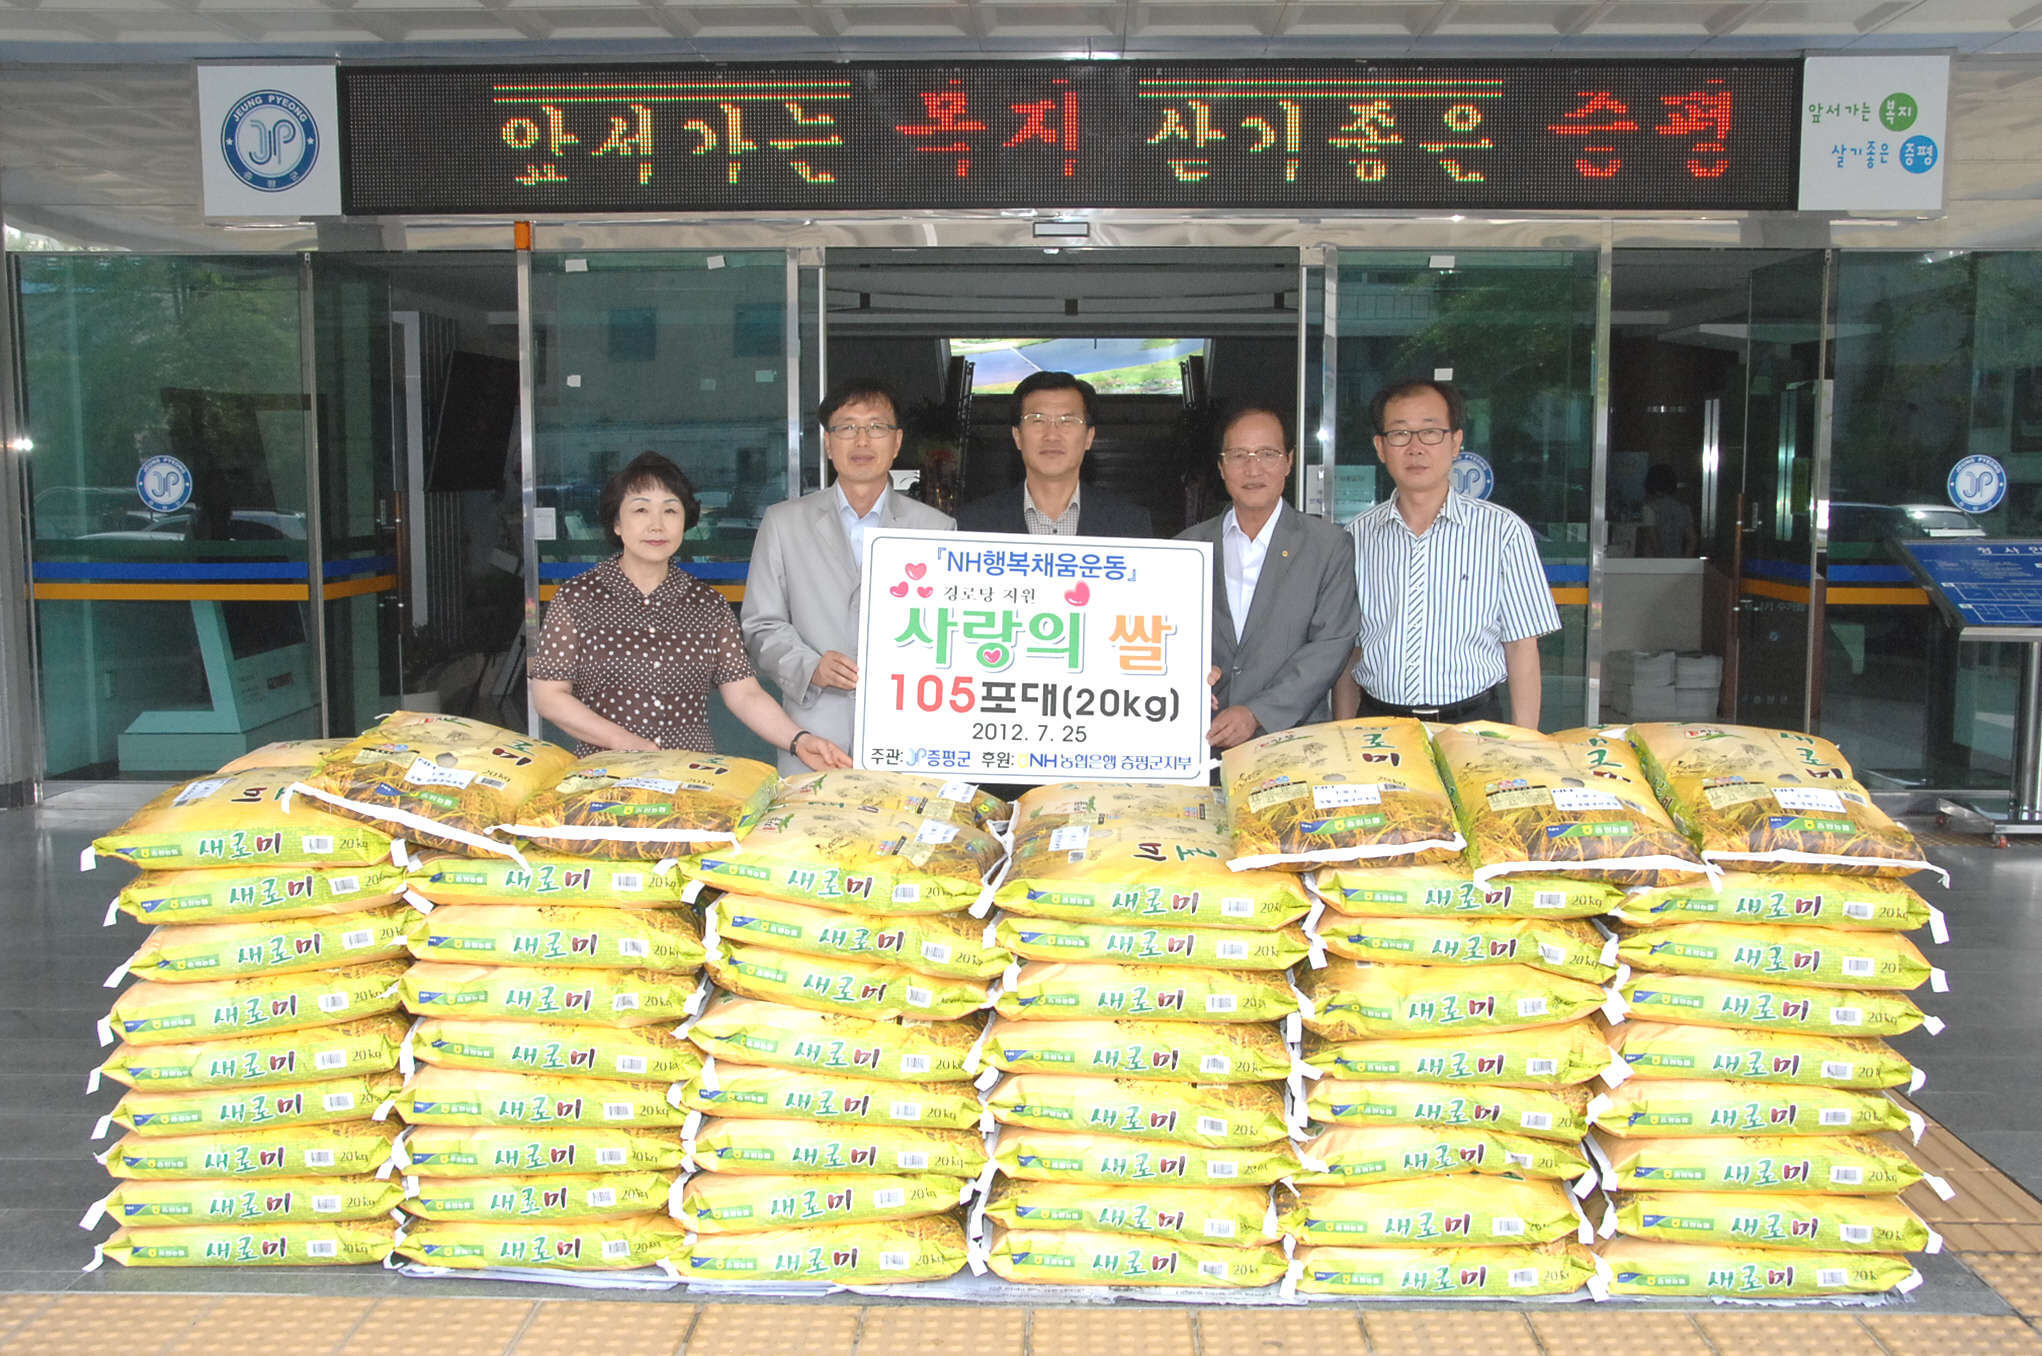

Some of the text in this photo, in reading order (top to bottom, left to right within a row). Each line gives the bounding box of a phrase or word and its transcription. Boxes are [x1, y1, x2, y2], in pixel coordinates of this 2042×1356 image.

[233, 95, 308, 122] JEUNG PYEONG
[1808, 100, 1912, 125] 앞서가는 복지
[1831, 140, 1934, 169] 살기좋은 증평
[143, 457, 186, 474] JEUNG PYEONG
[1955, 457, 2002, 474] JEUNG PYEONG
[937, 546, 1137, 582] 『NH행복채움운동』
[943, 585, 1036, 605] 경로당 지원
[894, 607, 1173, 674] 사랑의 쌀
[890, 673, 1180, 723] 105포대(20kg)
[972, 722, 1087, 743] 2012. 7. 25
[871, 748, 904, 766] 주관:
[926, 750, 972, 768] 증평군
[981, 751, 1014, 769] 후원:
[1120, 754, 1192, 771] 증평군지부
[198, 831, 281, 859] 새로미
[229, 875, 314, 907] 새로미
[505, 865, 592, 893] 새로미
[787, 869, 873, 898] 새로미
[1112, 887, 1199, 914] 새로미
[1425, 882, 1512, 911] 새로미
[1735, 893, 1822, 919] 새로미
[238, 933, 321, 964] 새로미
[513, 931, 597, 958] 새로미
[819, 928, 905, 953] 새로미
[1107, 930, 1194, 958] 새로미
[1431, 935, 1516, 961] 새로미
[1734, 946, 1820, 973] 새로미
[505, 986, 592, 1012] 새로미
[803, 973, 887, 1002] 새로미
[1098, 986, 1184, 1013] 새로미
[213, 994, 297, 1026] 새로미
[1408, 995, 1495, 1023] 새로미
[1722, 994, 1809, 1021] 새로미
[210, 1050, 295, 1079] 새로미
[512, 1043, 595, 1069] 새로미
[794, 1041, 880, 1069] 새로미
[1093, 1045, 1178, 1071] 새로미
[1417, 1052, 1504, 1078] 새로미
[1712, 1050, 1800, 1077] 새로미
[220, 1093, 301, 1122] 새로미
[498, 1095, 581, 1122] 새로미
[785, 1090, 869, 1117] 새로미
[1414, 1099, 1500, 1125] 새로미
[1711, 1103, 1796, 1130] 새로미
[1091, 1106, 1177, 1132] 새로미
[205, 1147, 284, 1173] 새로미
[494, 1143, 574, 1170] 새로미
[792, 1143, 876, 1168] 새로미
[1100, 1153, 1185, 1179] 새로미
[1403, 1144, 1485, 1170] 새로미
[1723, 1160, 1809, 1186] 새로미
[209, 1191, 291, 1218] 새로미
[490, 1187, 567, 1214] 새로미
[771, 1189, 851, 1219] 새로미
[1098, 1205, 1185, 1231] 새로미
[1385, 1211, 1470, 1239] 새로미
[1731, 1213, 1818, 1239] 새로미
[206, 1237, 286, 1262] 새로미
[500, 1237, 581, 1263] 새로미
[774, 1247, 858, 1274] 새로미
[1093, 1250, 1178, 1275] 새로미
[1402, 1266, 1486, 1291] 새로미
[1707, 1264, 1793, 1292] 새로미
